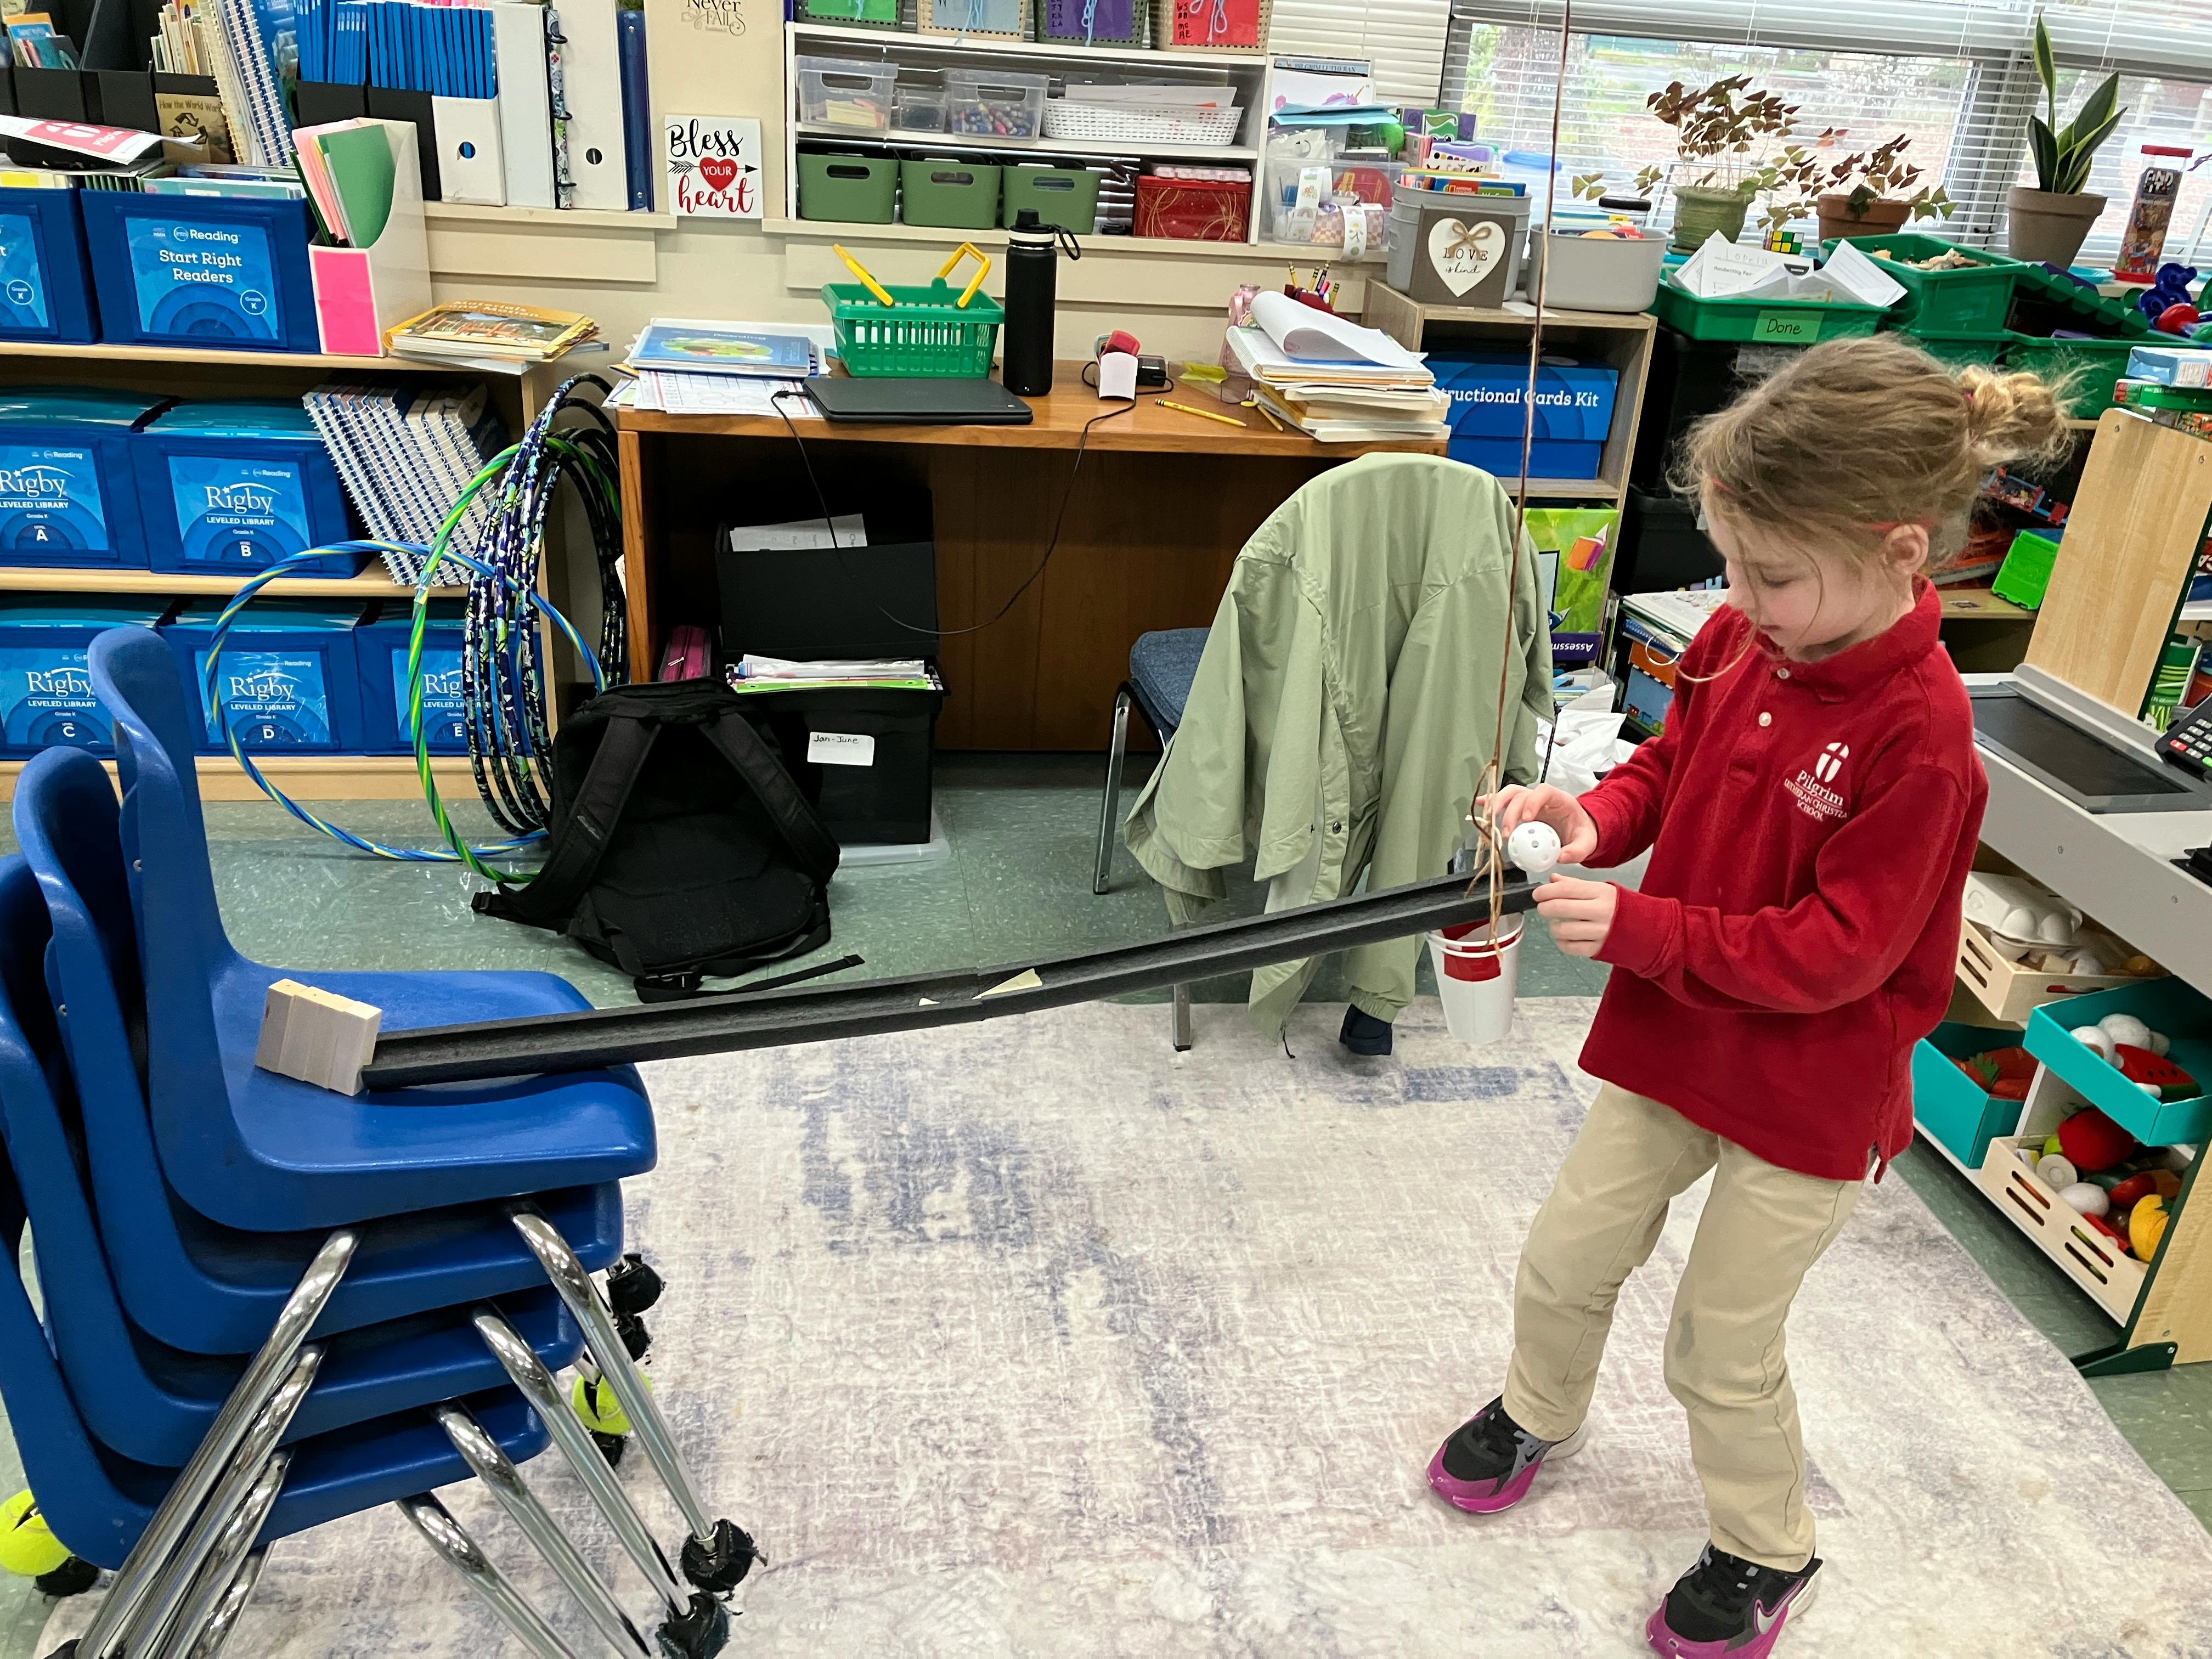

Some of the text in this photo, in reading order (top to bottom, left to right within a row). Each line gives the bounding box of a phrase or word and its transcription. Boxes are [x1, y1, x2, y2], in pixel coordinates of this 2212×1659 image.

[666, 119, 743, 157] Bless
[703, 166, 732, 176] YOUR
[678, 174, 754, 214] heart
[190, 229, 239, 244] Reading
[159, 250, 242, 268] Start Right
[1442, 247, 1488, 261] LOVE
[1454, 262, 1481, 273] kind
[173, 268, 233, 284] Readers
[1767, 318, 1802, 335] Done
[1525, 390, 1571, 405] Cards
[1575, 392, 1599, 407] Kit
[53, 452, 83, 460] Reading
[0, 469, 65, 498] Rigby
[204, 486, 273, 515] Rigby
[206, 516, 240, 524] LEVELED
[36, 529, 48, 541] A
[241, 545, 251, 557] B
[25, 670, 92, 698] Rigby
[229, 676, 294, 702] Rigby
[63, 726, 76, 737] C
[263, 729, 274, 739] D
[454, 726, 462, 737] E
[836, 736, 859, 744] June
[1784, 778, 1813, 804] LUTHERAN
[1796, 770, 1843, 806] Pilgrim
[1797, 799, 1824, 822] SCHOOL
